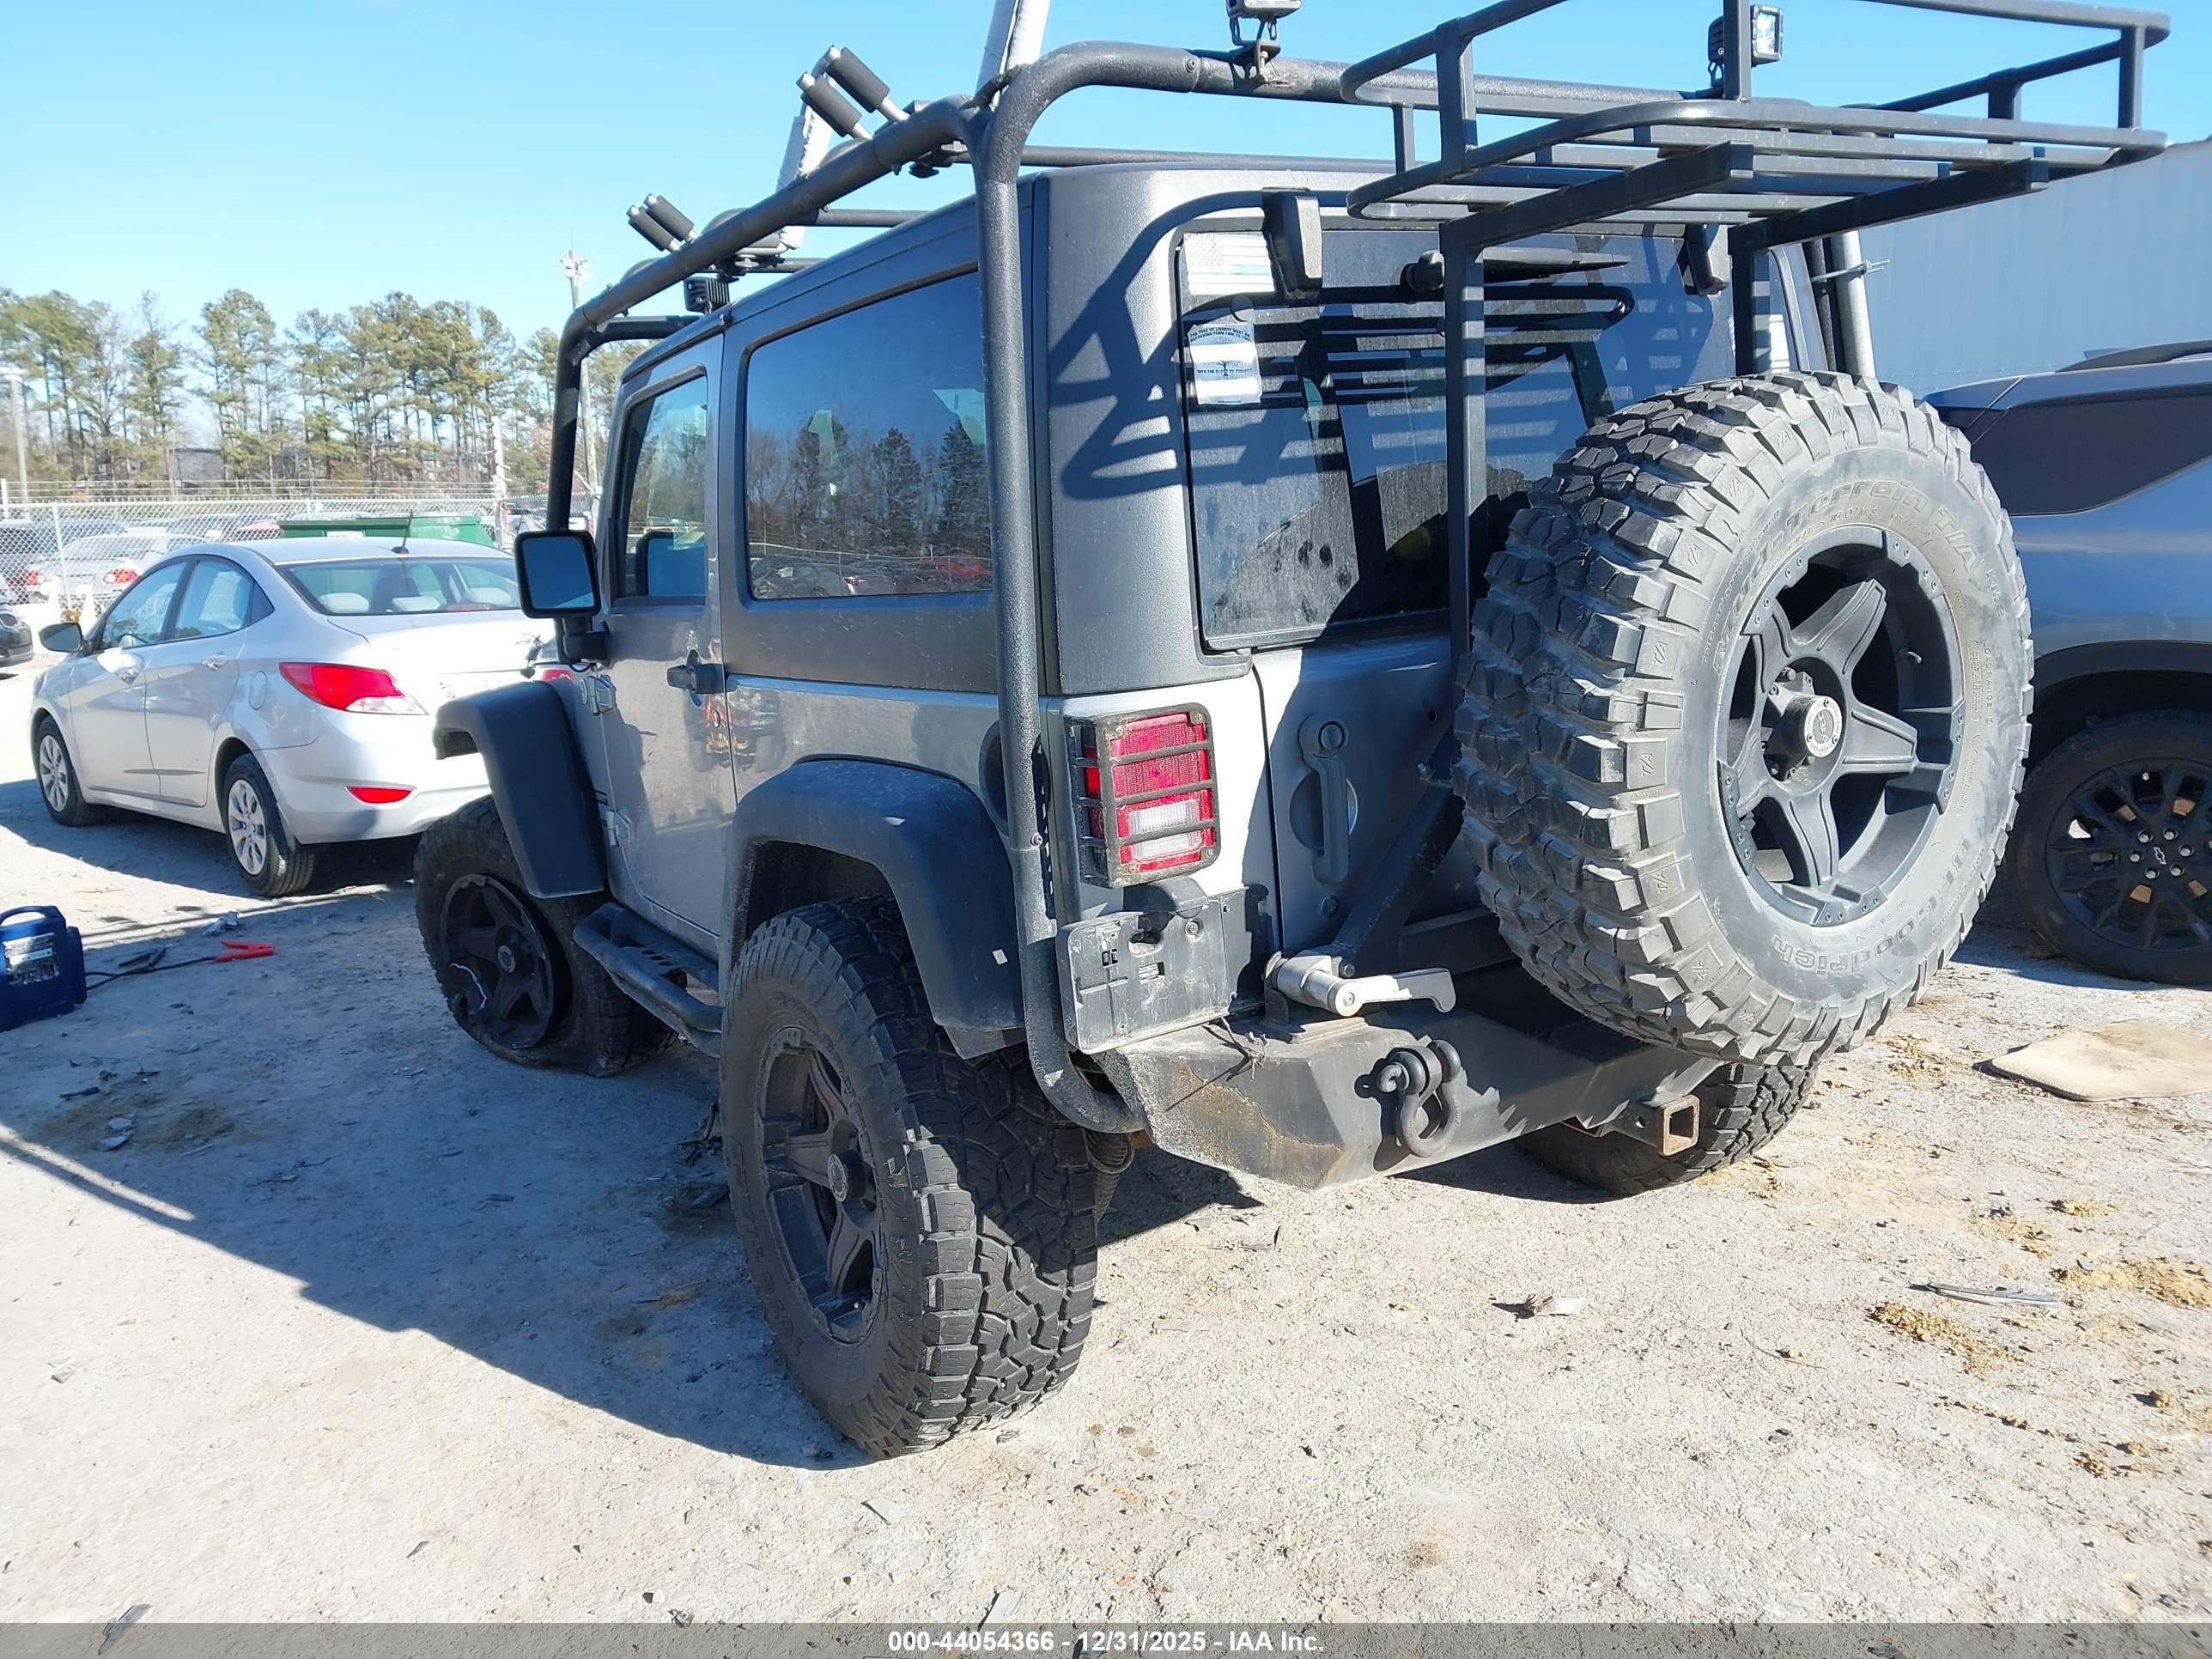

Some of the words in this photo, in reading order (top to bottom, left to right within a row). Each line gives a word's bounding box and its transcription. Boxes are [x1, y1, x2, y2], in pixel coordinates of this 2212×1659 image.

[1828, 406, 1842, 421] T/A
[1726, 478, 1743, 498] T/A
[1686, 543, 1702, 568] T/A
[1711, 480, 1930, 675] Mud-Terrain
[1934, 503, 1980, 575] T/A
[1654, 640, 1668, 665] T/A
[1641, 751, 1655, 777] T/A
[1653, 870, 1670, 894] T/A
